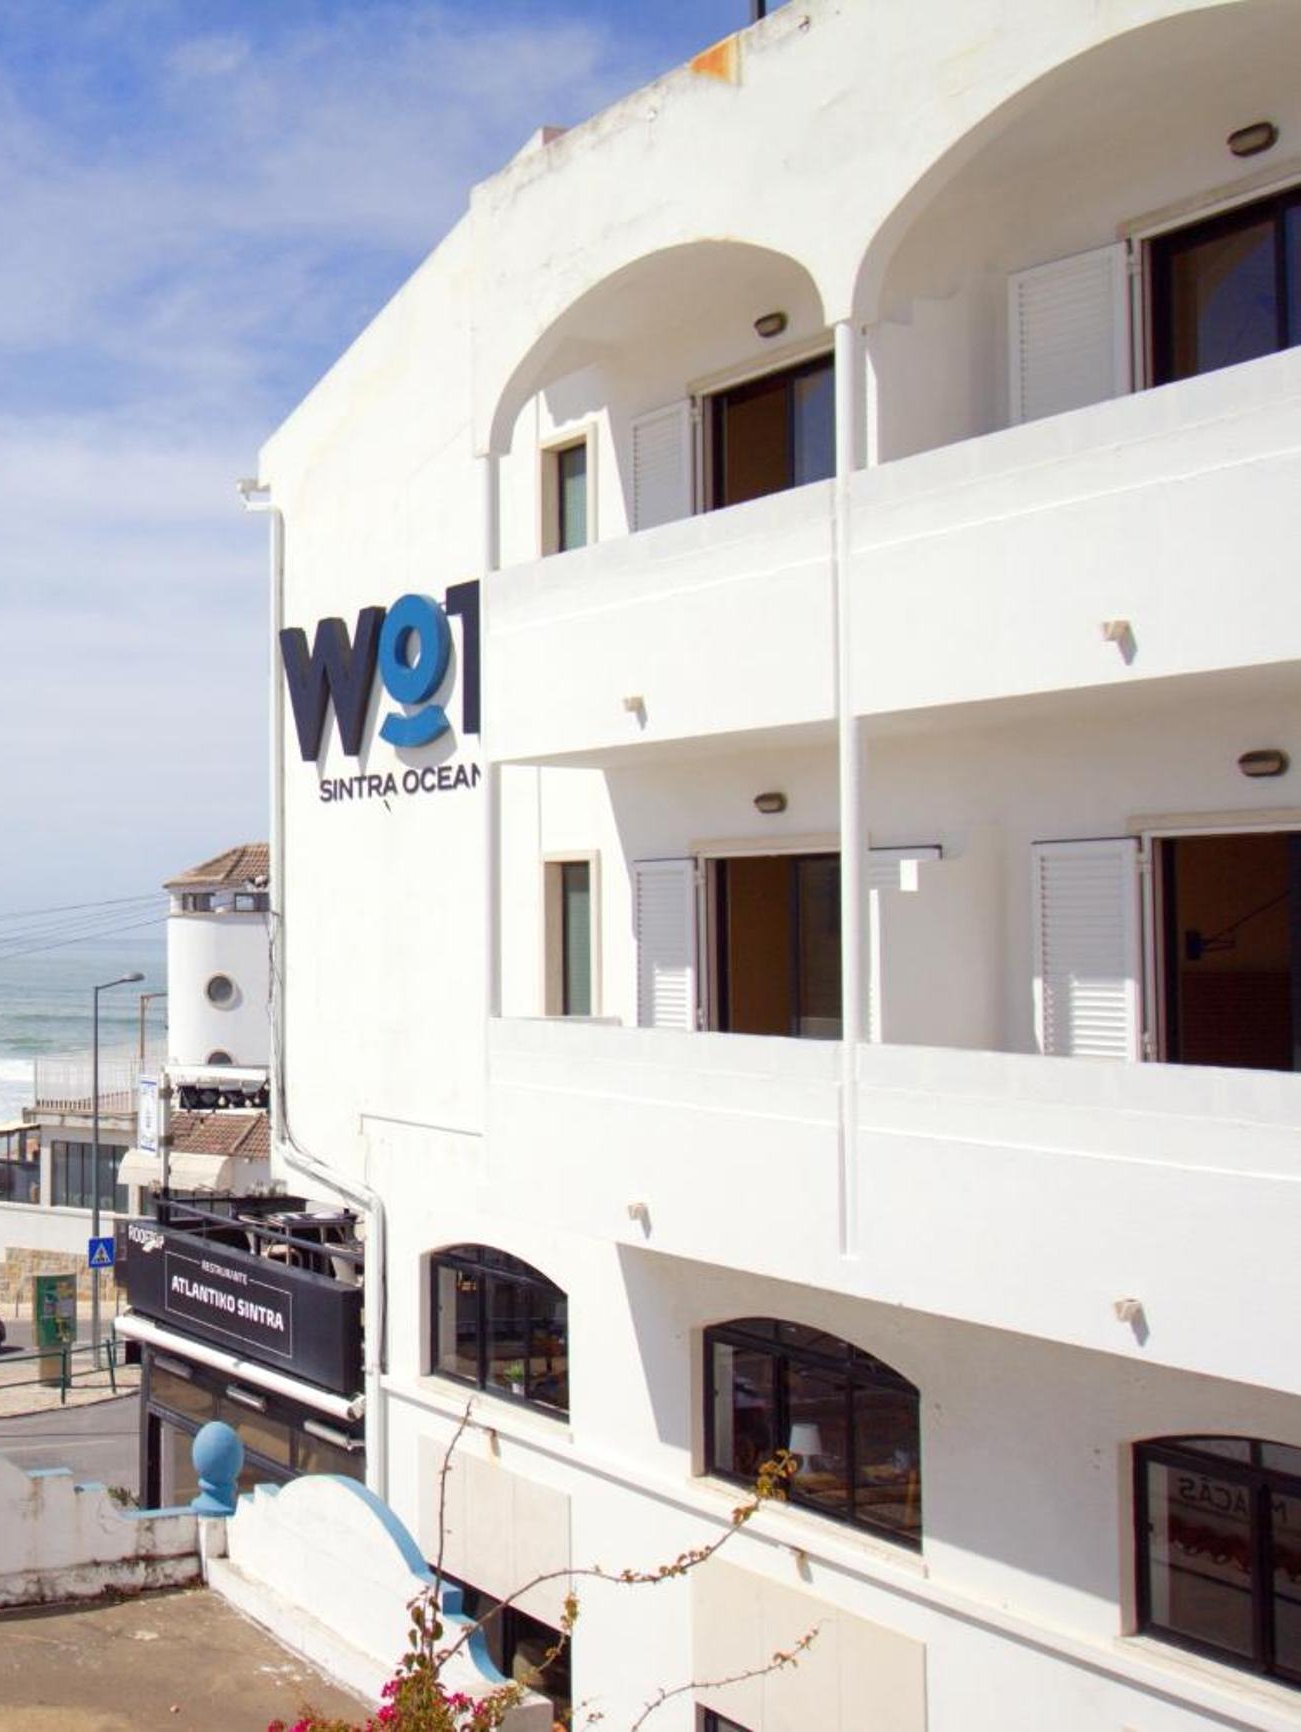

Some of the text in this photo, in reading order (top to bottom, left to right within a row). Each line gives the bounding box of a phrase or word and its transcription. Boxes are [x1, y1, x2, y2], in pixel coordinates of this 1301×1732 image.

[320, 772, 397, 802] SINTRA
[171, 1275, 284, 1332] ATLANTIKO SINTRA
